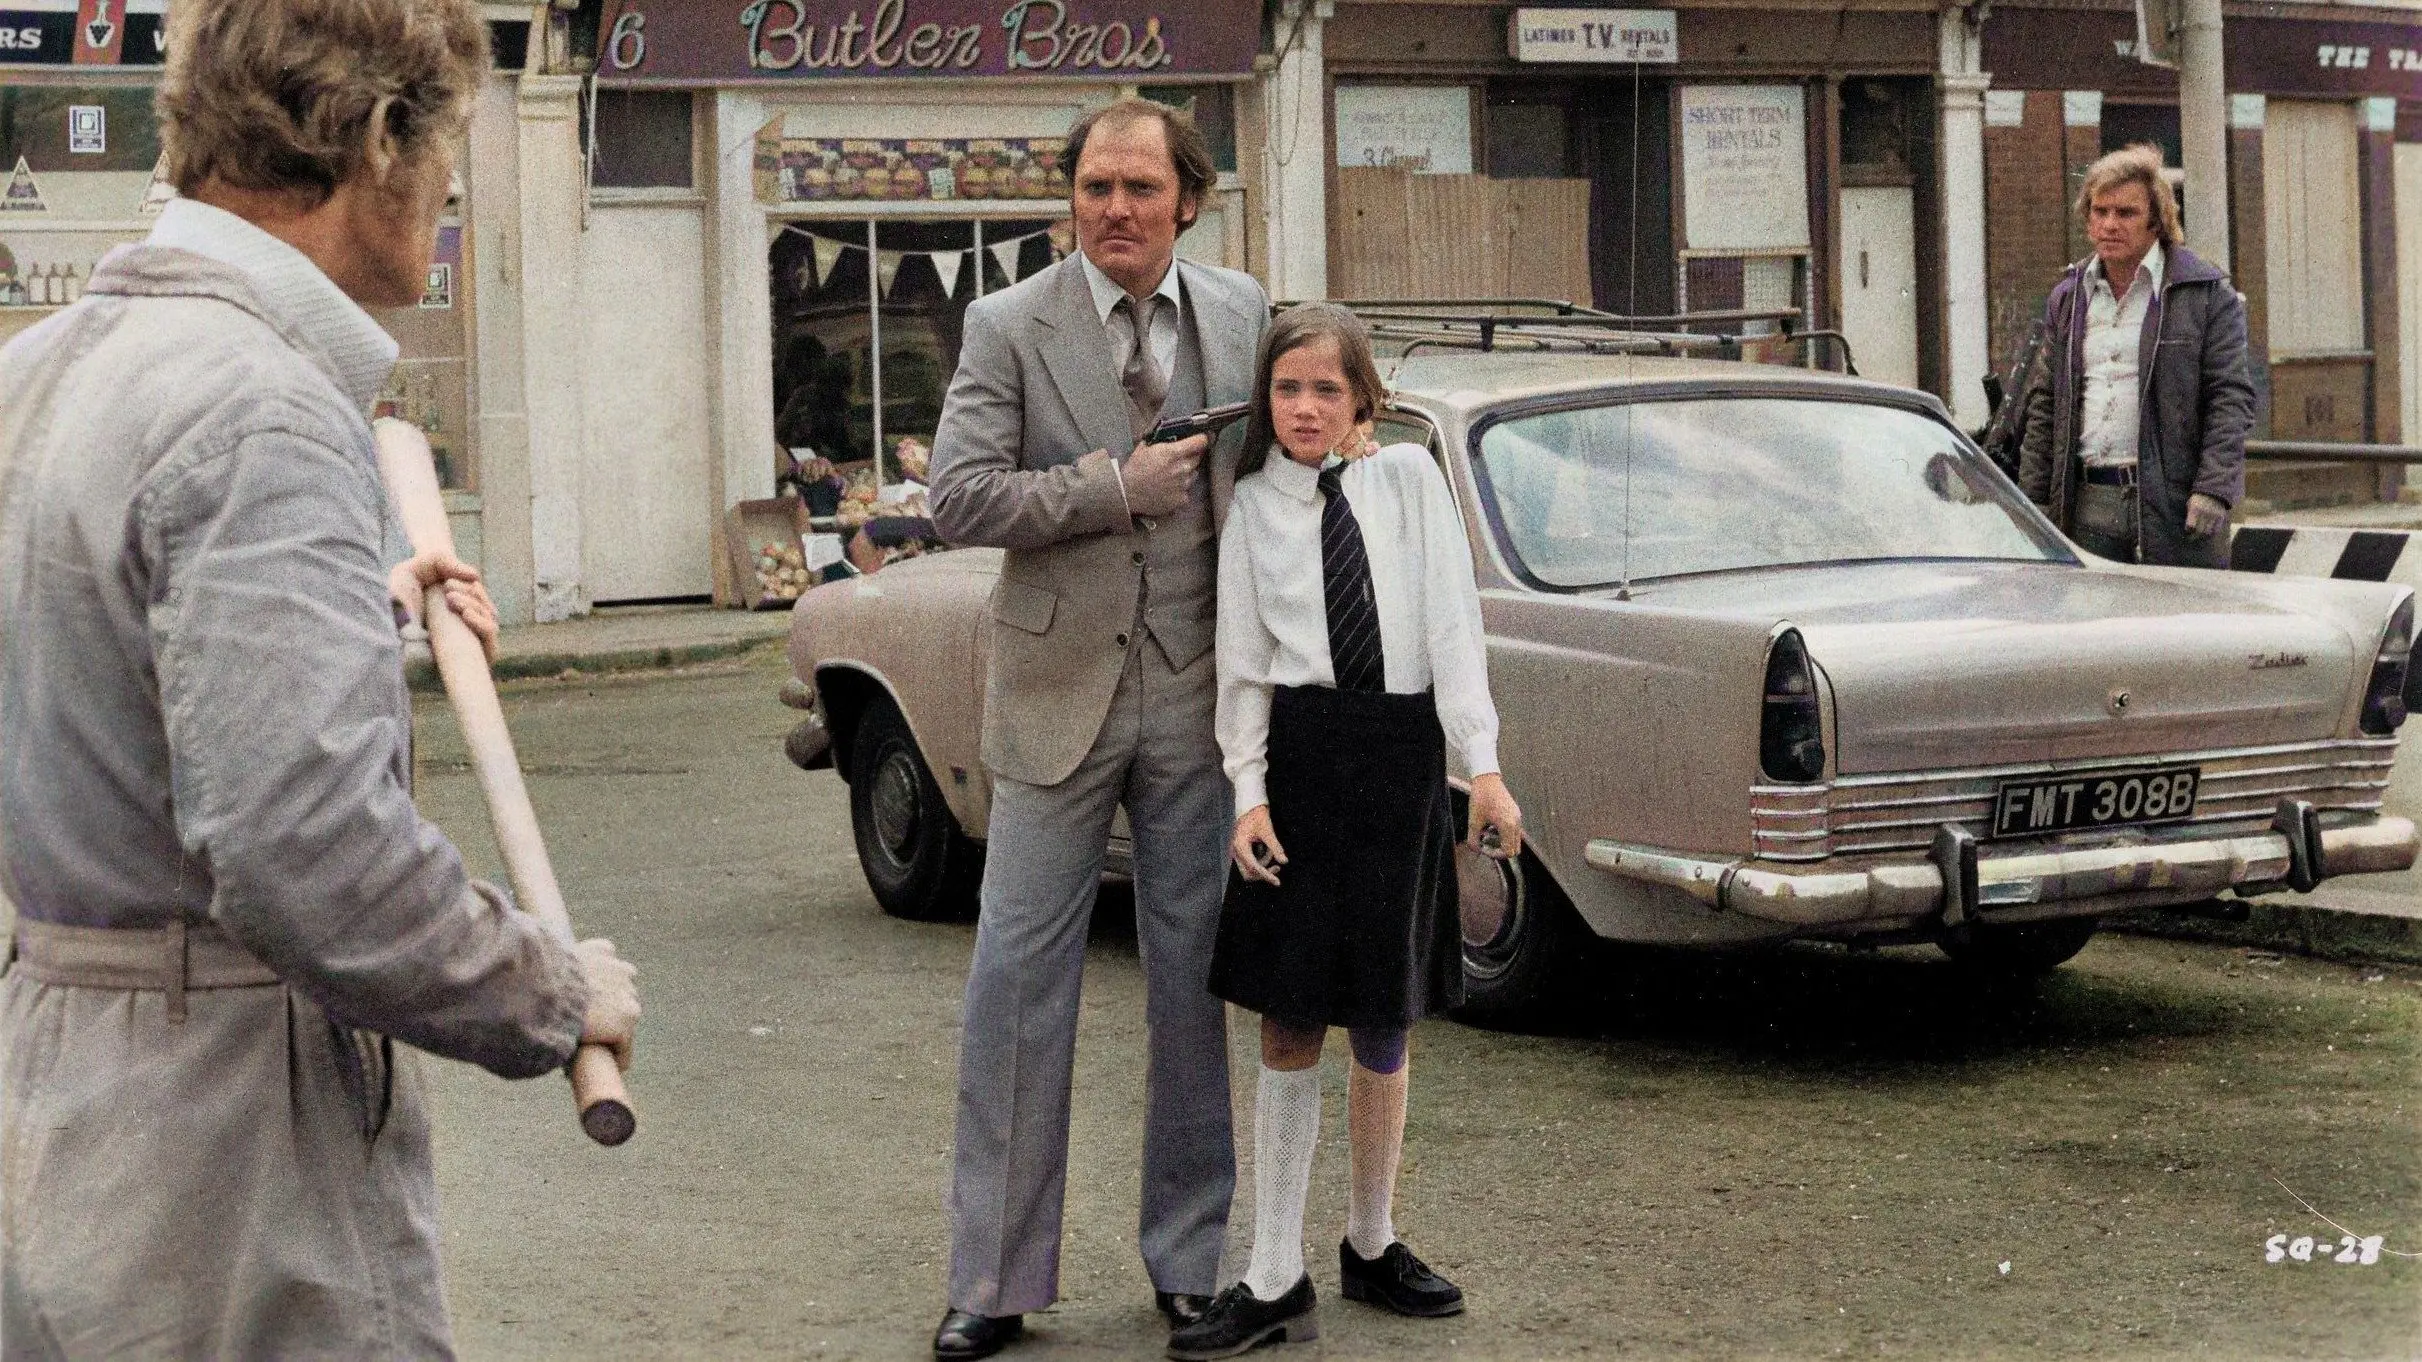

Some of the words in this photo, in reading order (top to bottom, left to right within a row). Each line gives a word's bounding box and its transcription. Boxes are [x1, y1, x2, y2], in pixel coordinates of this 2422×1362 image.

[610, 12, 646, 71] 6
[739, 0, 983, 70] Butler
[1001, 0, 1172, 70] Bros.
[1620, 28, 1670, 45] RENTALS
[2317, 45, 2370, 69] THE
[1688, 106, 1745, 124] SHORT
[1748, 105, 1791, 124] TERM
[1706, 129, 1783, 149] RENTALS
[2001, 782, 2085, 831] FMT
[2091, 772, 2194, 822] 308B
